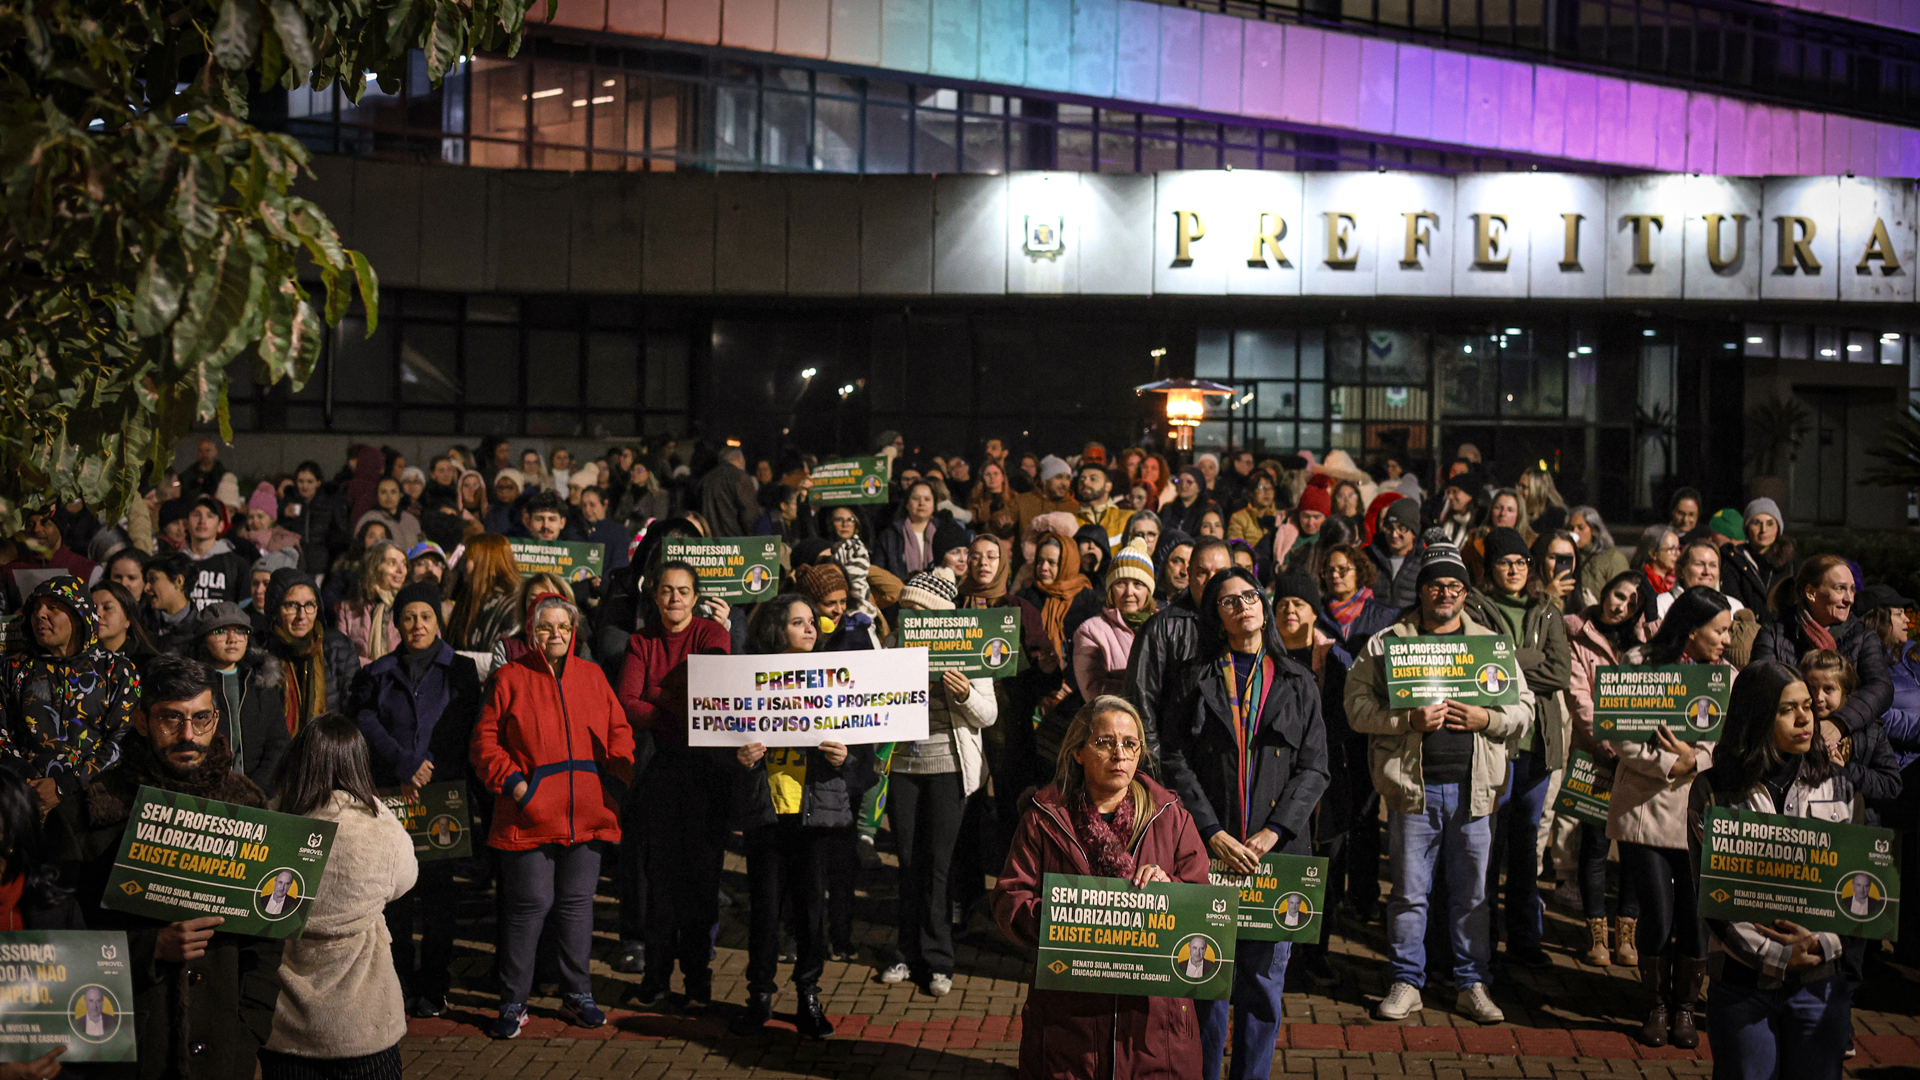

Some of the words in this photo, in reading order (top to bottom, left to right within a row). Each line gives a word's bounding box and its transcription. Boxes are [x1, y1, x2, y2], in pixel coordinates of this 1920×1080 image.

[1170, 210, 1903, 273] PREFEITURA
[667, 545, 684, 555] SEM
[558, 556, 573, 566] NÃO
[727, 555, 745, 566] NÃO
[199, 570, 226, 590] OLA
[904, 618, 921, 628] SEM
[966, 628, 983, 639] NÃO
[933, 640, 974, 651] CAMPEÃO.
[1390, 644, 1408, 655] SEM
[1455, 654, 1474, 665] NÃO
[755, 667, 855, 690] PREFEITO,
[1392, 666, 1421, 678] EXISTE
[1423, 665, 1466, 677] CAMPEÃO.
[1600, 672, 1619, 684] SEM
[1620, 671, 1682, 684] PROFESSOR(A)
[1600, 685, 1665, 697] VALORIZADO(A)
[1668, 684, 1687, 696] NÃO
[693, 697, 730, 710] PARE
[733, 697, 752, 710] DE
[758, 696, 801, 711] PISAR
[804, 695, 833, 709] NOS
[838, 690, 928, 707] PROFESSORES,
[1600, 697, 1629, 708] EXISTE
[1631, 696, 1676, 708] CAMPEÃO.
[693, 716, 700, 730] E
[703, 716, 756, 732] PAGUE
[814, 713, 881, 730] SALARIAL
[1575, 758, 1593, 772] SEM
[141, 802, 174, 824] SEM
[173, 809, 267, 845] PROFESSOR(A)
[136, 822, 239, 861] VALORIZADO(A)
[239, 842, 270, 862] NÃO
[1712, 818, 1739, 836] SEM
[1742, 821, 1831, 850] PROFESSOR(A)
[128, 842, 182, 868] EXISTE
[179, 853, 246, 880] CAMPEÃO.
[1711, 836, 1807, 866] VALORIZADO(A)
[1810, 848, 1838, 867] NÃO
[1710, 854, 1753, 874] EXISTE
[1756, 861, 1822, 883] CAMPEÃO.
[1256, 876, 1278, 889] NÃO
[145, 891, 178, 907] EDUCAÇÃO
[178, 898, 212, 913] MUNICIPAL
[212, 905, 220, 914] DE
[148, 883, 172, 895] RENATO
[172, 887, 191, 900] SILVA,
[192, 892, 215, 903] INVISTA
[216, 896, 226, 904] NA
[1051, 887, 1078, 904] SEM
[1081, 888, 1170, 914] PROFESSOR(A)
[1050, 906, 1145, 931] VALORIZADO(A)
[1148, 912, 1176, 930] NÃO
[1049, 925, 1092, 943] EXISTE
[1094, 928, 1160, 948] CAMPEÃO.
[36, 962, 67, 982] NÃO
[1071, 968, 1101, 978] EDUCAÇÃO
[1102, 970, 1132, 980] MUNICIPAL
[1072, 960, 1094, 968] RENATO
[1112, 962, 1135, 971] INVISTA
[1136, 964, 1144, 972] NA
